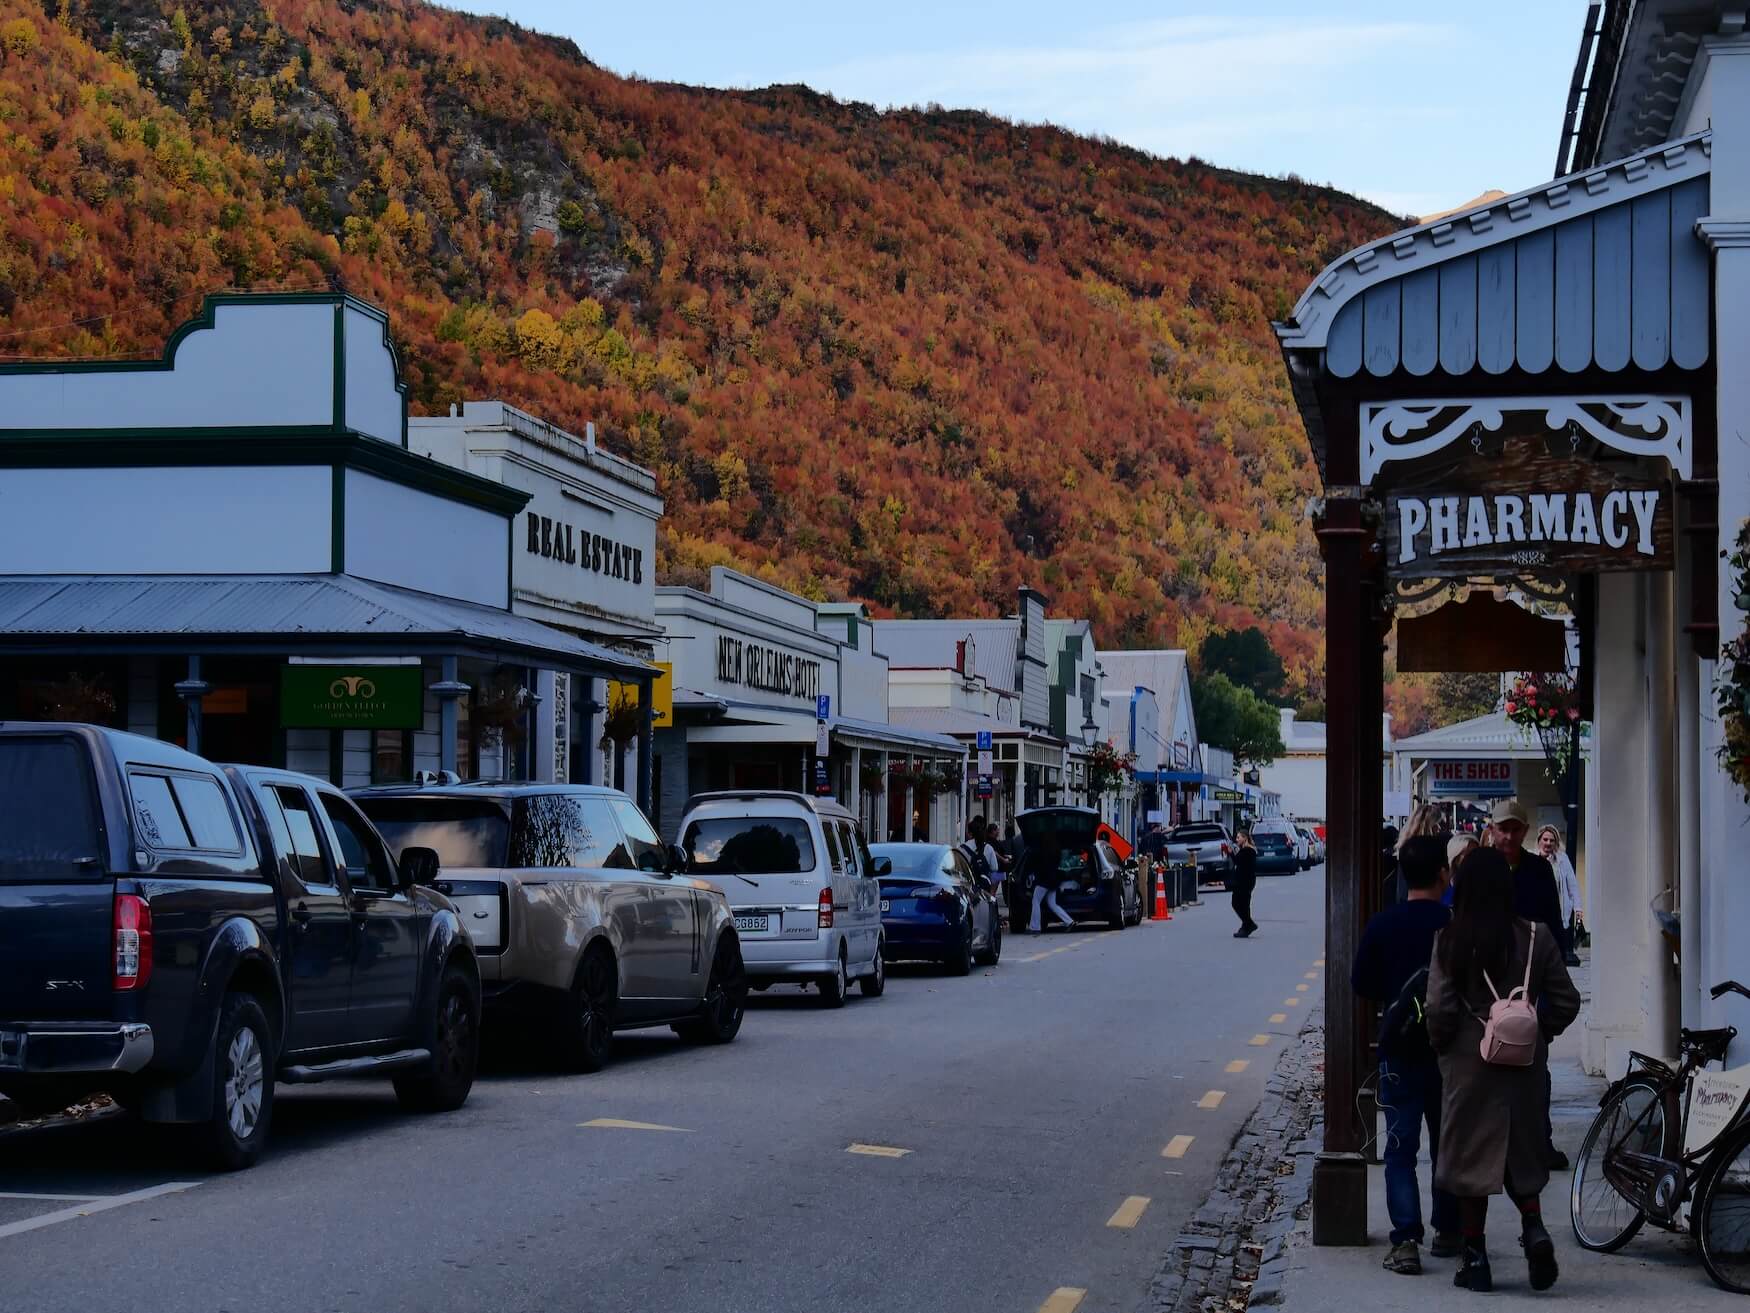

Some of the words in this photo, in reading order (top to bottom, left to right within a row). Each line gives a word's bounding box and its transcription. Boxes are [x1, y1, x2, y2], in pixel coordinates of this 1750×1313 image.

[527, 512, 576, 565] REAL
[580, 530, 642, 584] ESTATE
[1397, 490, 1660, 565] PHARMACY
[718, 635, 742, 684] NEW
[746, 643, 792, 696] ORLEANS
[794, 656, 820, 702] HOTEL
[1433, 763, 1464, 779] THE
[1467, 763, 1511, 779] SHED
[735, 918, 766, 929] CG862
[1695, 1087, 1738, 1111] Pharmacy
